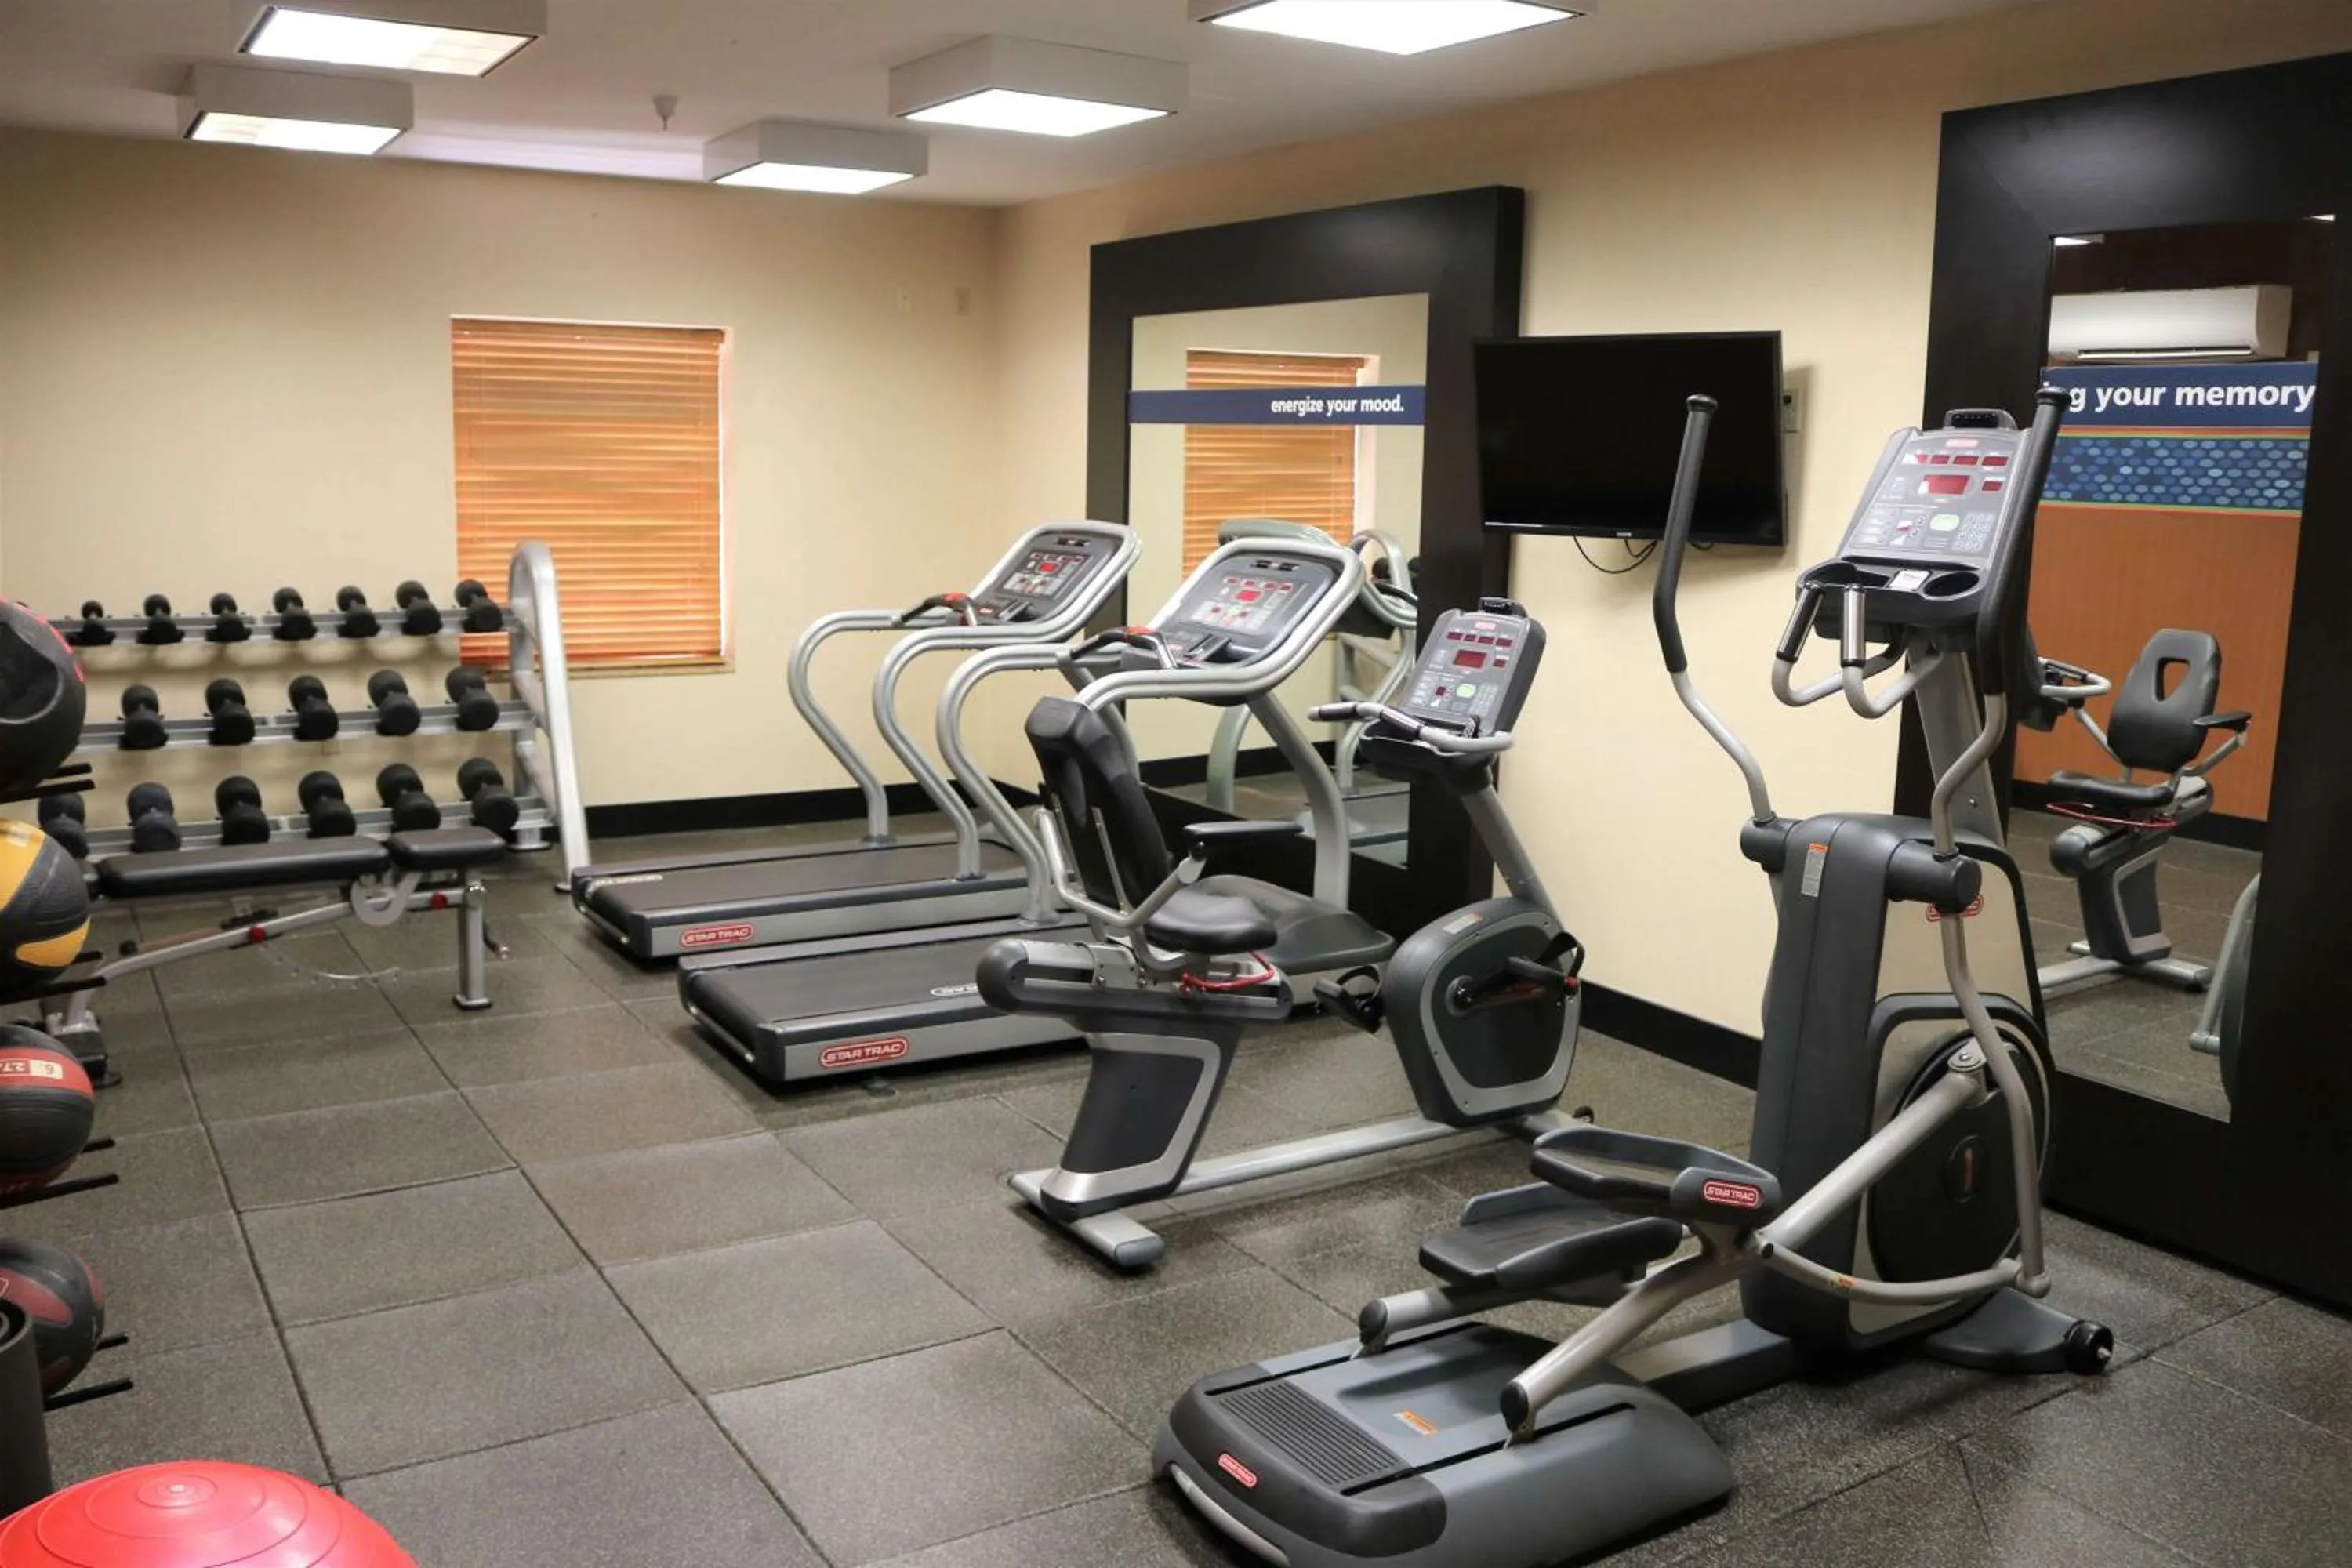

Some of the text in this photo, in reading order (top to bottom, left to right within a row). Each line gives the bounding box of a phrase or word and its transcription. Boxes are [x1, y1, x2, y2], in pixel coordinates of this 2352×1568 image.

[1271, 394, 1404, 417] energize your mood.
[2094, 386, 2167, 413] your
[2175, 385, 2317, 413] memory
[686, 927, 749, 944] STAR TRAC
[826, 1043, 903, 1062] STAR TRAC
[1707, 1186, 1755, 1201] STAR TRAC
